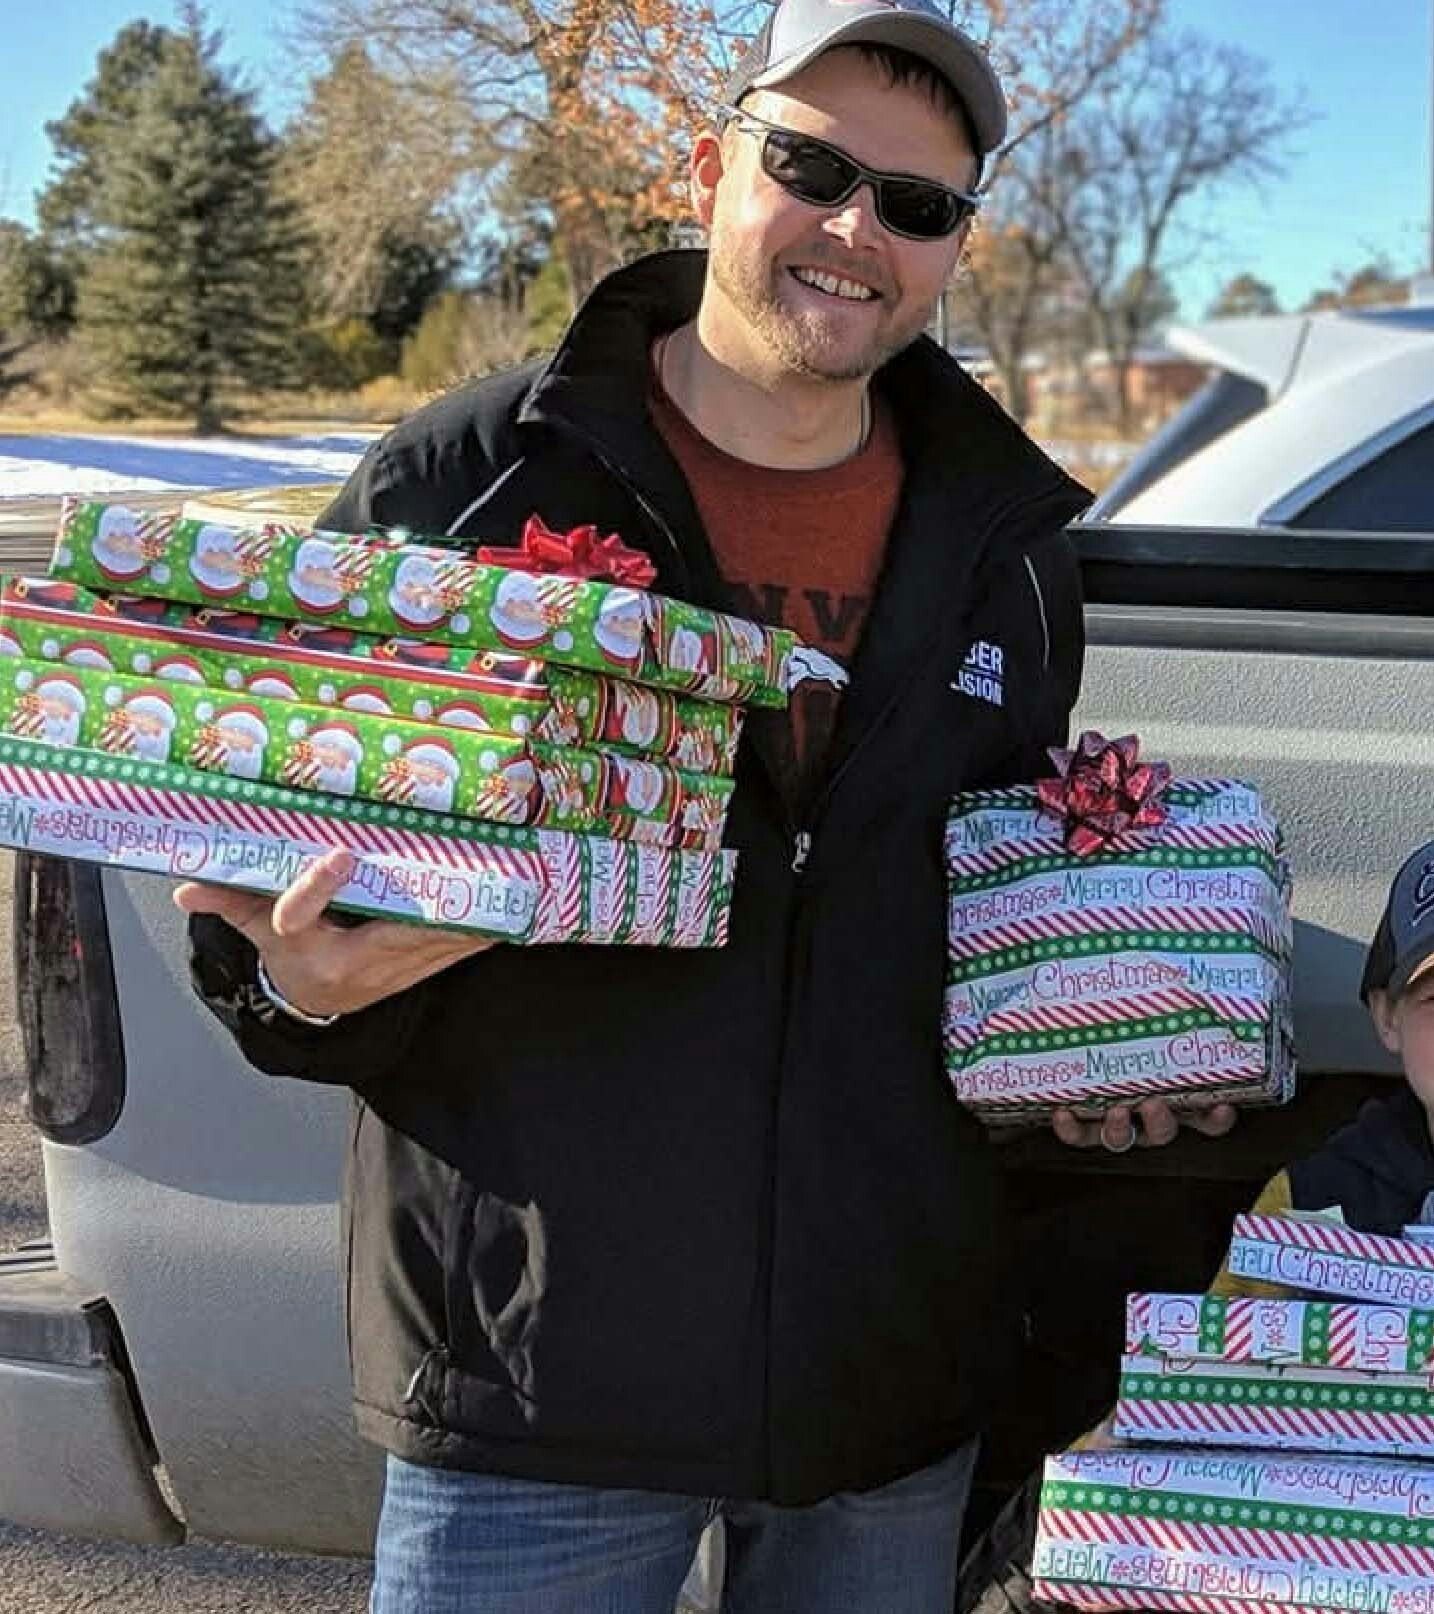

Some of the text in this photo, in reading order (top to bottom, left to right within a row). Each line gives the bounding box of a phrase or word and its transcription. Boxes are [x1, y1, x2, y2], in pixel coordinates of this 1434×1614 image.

[50, 809, 209, 874] Christmas
[211, 824, 300, 882] Merry
[1062, 870, 1146, 909] Merry
[1085, 1046, 1168, 1082] Merry
[1277, 1245, 1434, 1306] Christmas
